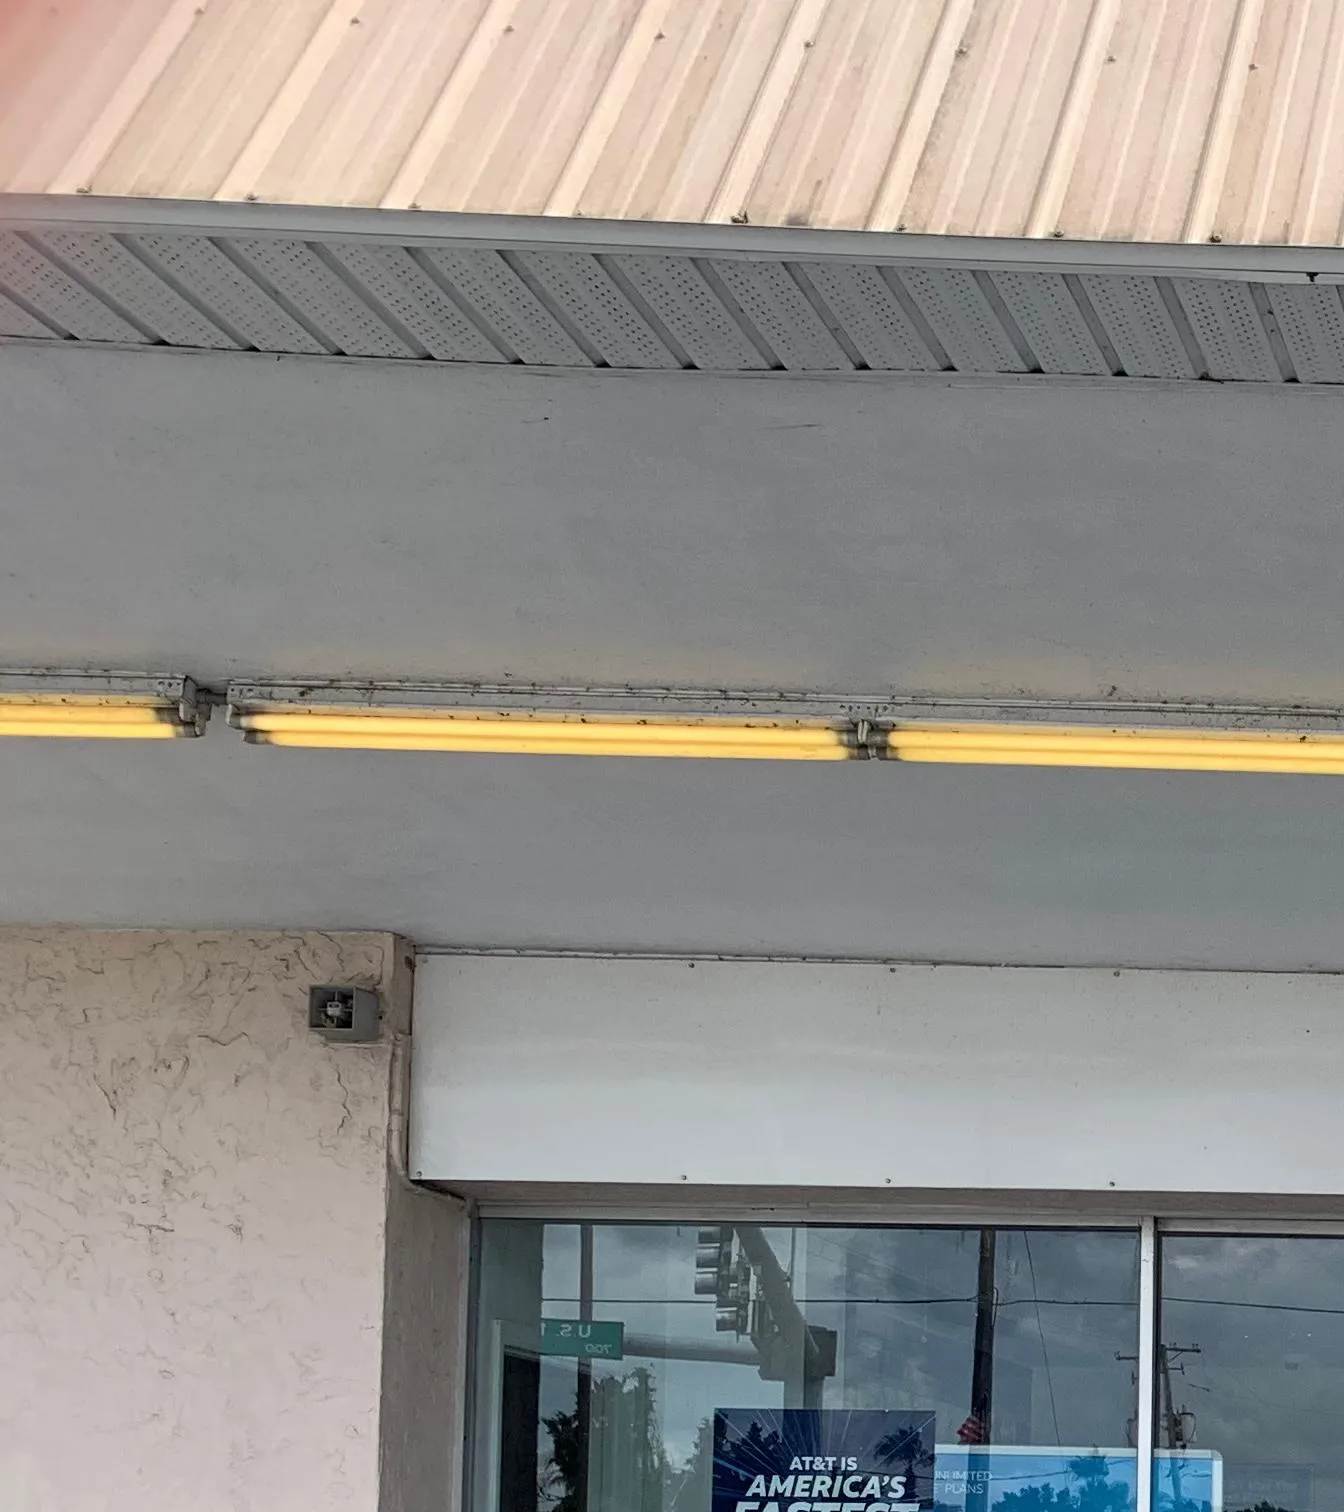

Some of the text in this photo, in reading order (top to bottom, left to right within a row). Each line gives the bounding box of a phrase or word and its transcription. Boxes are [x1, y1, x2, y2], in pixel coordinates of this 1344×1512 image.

[789, 1456, 858, 1471] AT&T IS
[745, 1474, 907, 1499] AMERICA'S
[945, 1484, 984, 1494] PLANS
